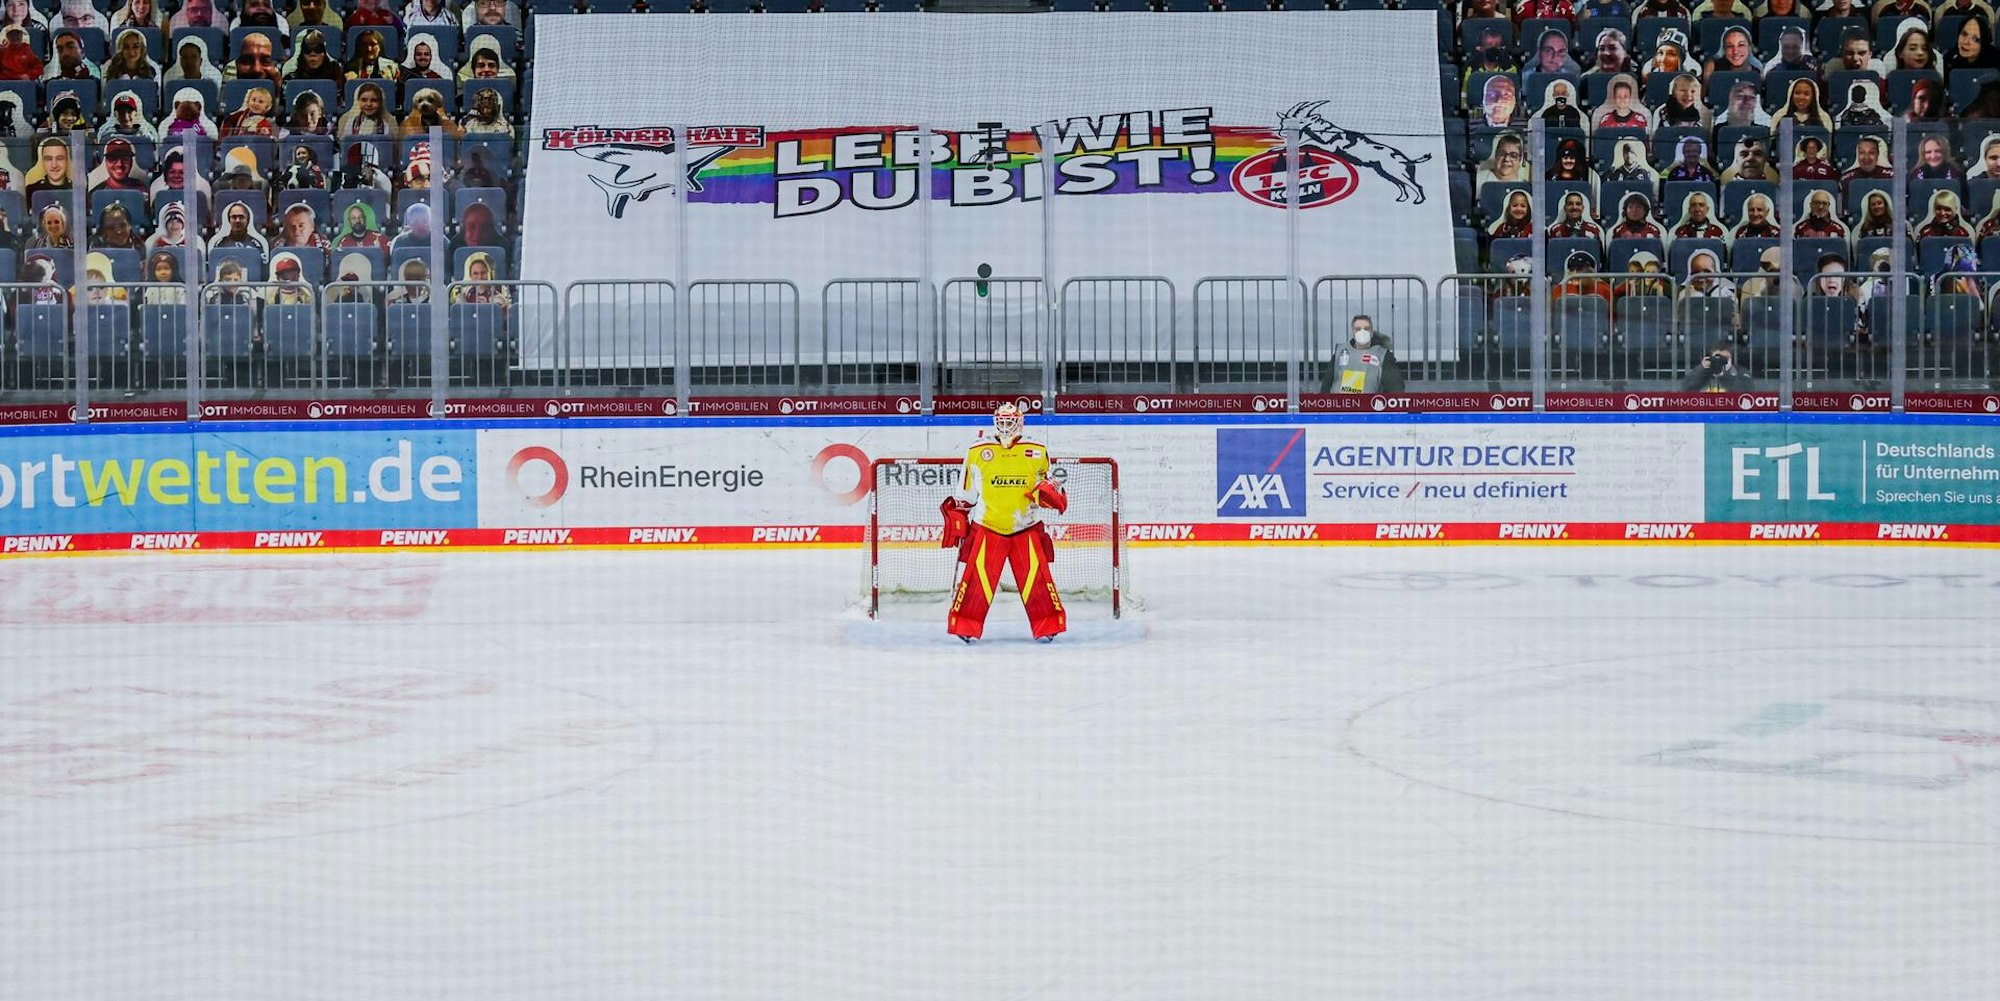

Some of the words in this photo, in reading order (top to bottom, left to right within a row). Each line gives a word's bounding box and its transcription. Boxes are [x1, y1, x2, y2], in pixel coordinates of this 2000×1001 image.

[548, 126, 672, 148] KÖLNER
[687, 127, 760, 145] HAIE
[774, 130, 1010, 176] LEBE
[1031, 106, 1213, 154] WIE
[773, 167, 919, 218] DU
[950, 138, 1219, 207] BIST!
[444, 403, 467, 414] OTT
[468, 402, 535, 414] IMMOBILIEN
[561, 402, 584, 413] OTT
[586, 402, 653, 413] IMMOBILIEN
[685, 401, 701, 412] TT
[702, 401, 769, 412] IMMOBILIEN
[795, 401, 818, 412] OTT
[819, 401, 887, 411] IMMOBILIEN
[912, 400, 937, 411] OT
[938, 400, 1004, 411] IMMOBILIEN
[1056, 400, 1124, 410] IMMOBILIEN
[1150, 399, 1174, 409] OTT
[1175, 399, 1242, 410] IMMOBILIEN
[1268, 399, 1288, 409] OT
[1299, 399, 1361, 409] MMOBILIEN
[1387, 398, 1411, 409] OTT
[1412, 398, 1480, 408] IMMOBILIEN
[1506, 398, 1530, 408] OTT
[1546, 398, 1614, 407] IMMOBILIEN
[1641, 397, 1664, 407] OTT
[1666, 397, 1734, 408] IMMOBILIEN
[1755, 397, 1778, 407] OTT
[1793, 397, 1839, 408] OBILIEN
[1866, 397, 1890, 408] OTT
[1904, 398, 1973, 408] IMMOBILIEN
[88, 407, 109, 418] OTT
[110, 406, 178, 418] IMMOBILIEN
[204, 405, 228, 416] OTT
[230, 405, 297, 416] IMMOBILIEN
[323, 404, 347, 415] OTT
[349, 404, 416, 415] IMMOBILIEN
[1313, 446, 1454, 467] AGENTUR
[1463, 446, 1576, 467] DECKER
[1876, 443, 1995, 459] Deutschlands
[1732, 442, 1836, 500] ETL
[1876, 464, 1899, 479] für
[581, 465, 763, 493] RheinEnergie
[1217, 474, 1292, 510] AXA
[1322, 481, 1400, 499] Service
[1424, 484, 1466, 498] neu
[1473, 480, 1568, 498] definiert
[1876, 490, 1941, 503] Sprechen
[1944, 490, 1965, 503] Sie
[1969, 494, 1993, 504] uns
[1546, 573, 2000, 591] TOYOT
